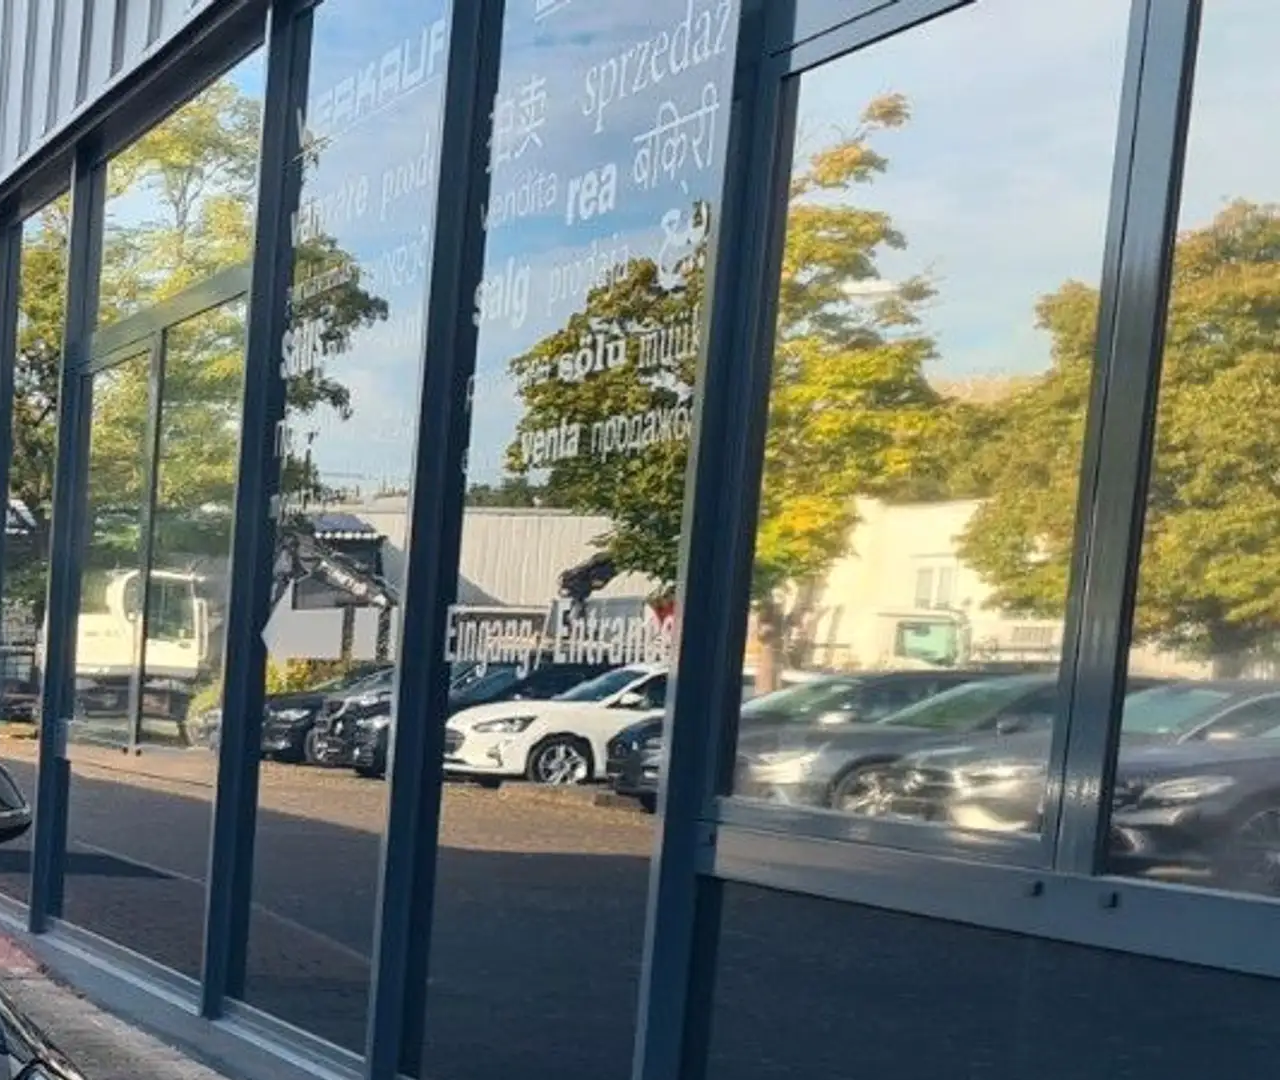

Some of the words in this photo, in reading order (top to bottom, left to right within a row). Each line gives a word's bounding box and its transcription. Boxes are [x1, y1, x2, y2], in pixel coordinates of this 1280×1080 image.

[565, 163, 618, 226] rea
[521, 416, 581, 465] venta
[444, 605, 533, 679] Eingang
